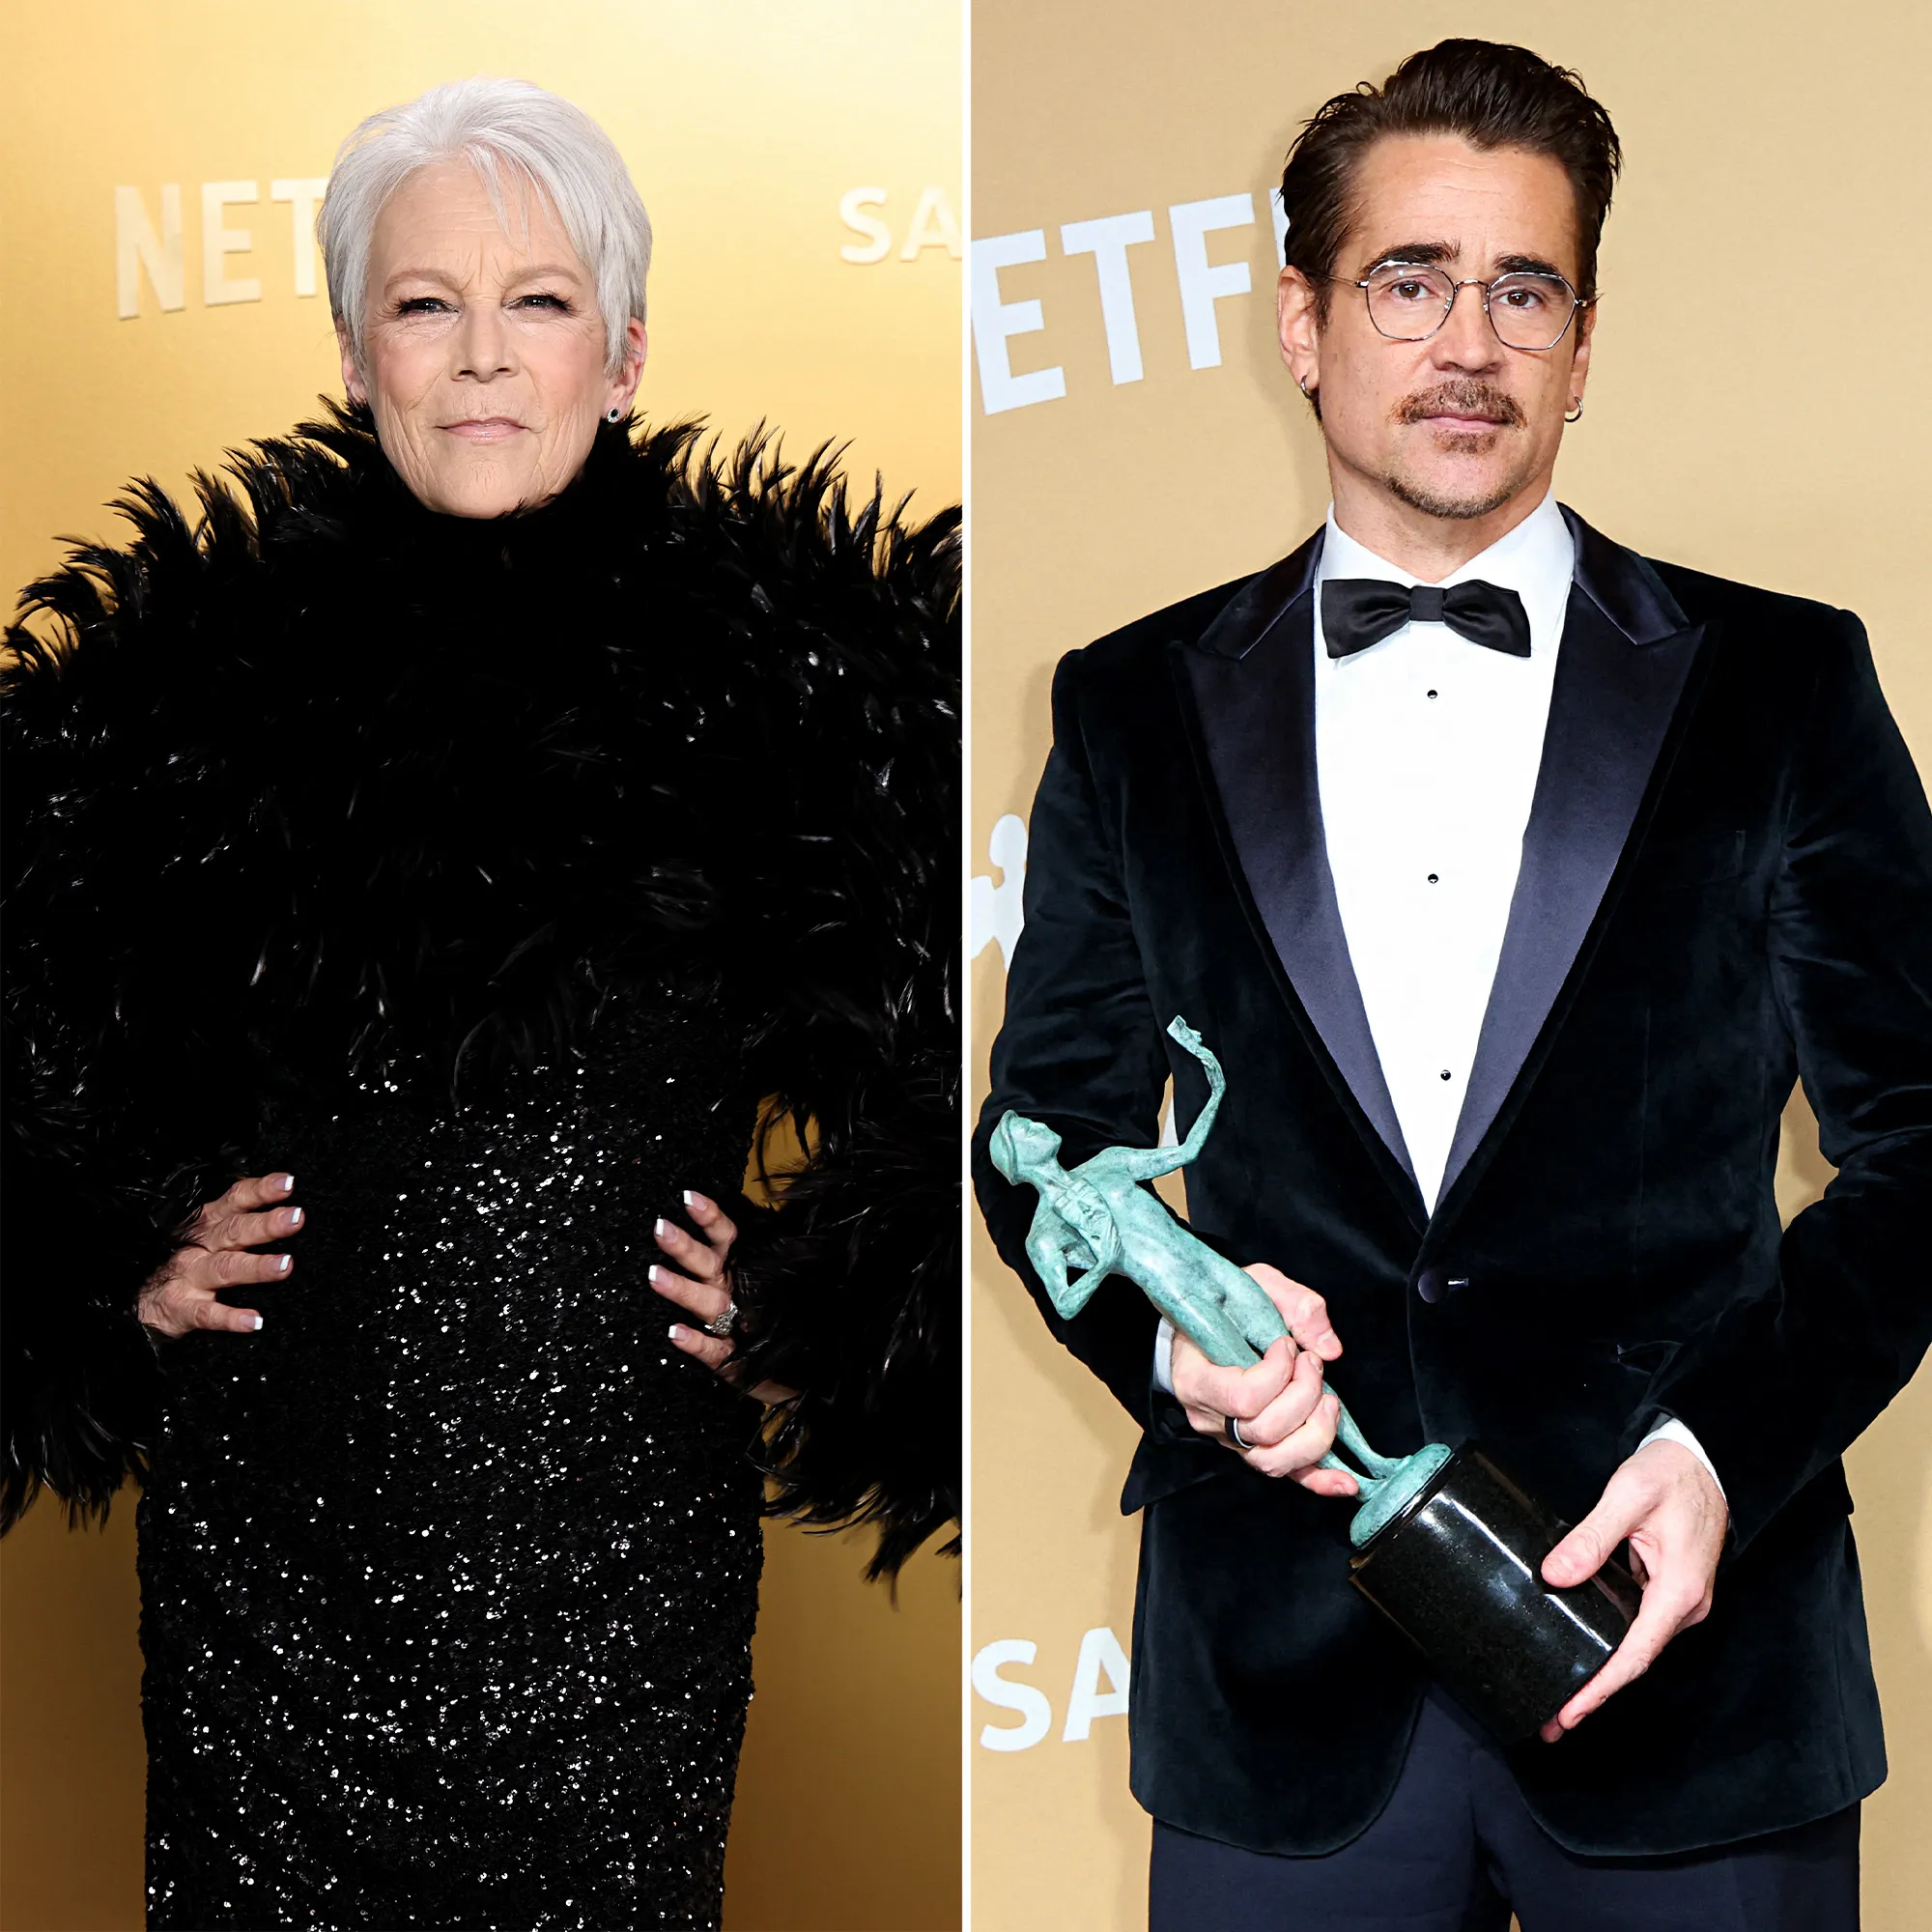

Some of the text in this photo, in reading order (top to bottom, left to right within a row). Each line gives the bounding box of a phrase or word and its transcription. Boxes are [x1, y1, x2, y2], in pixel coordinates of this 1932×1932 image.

[114, 178, 329, 319] NET
[838, 185, 962, 265] SA
[971, 1627, 1131, 1751] SA
